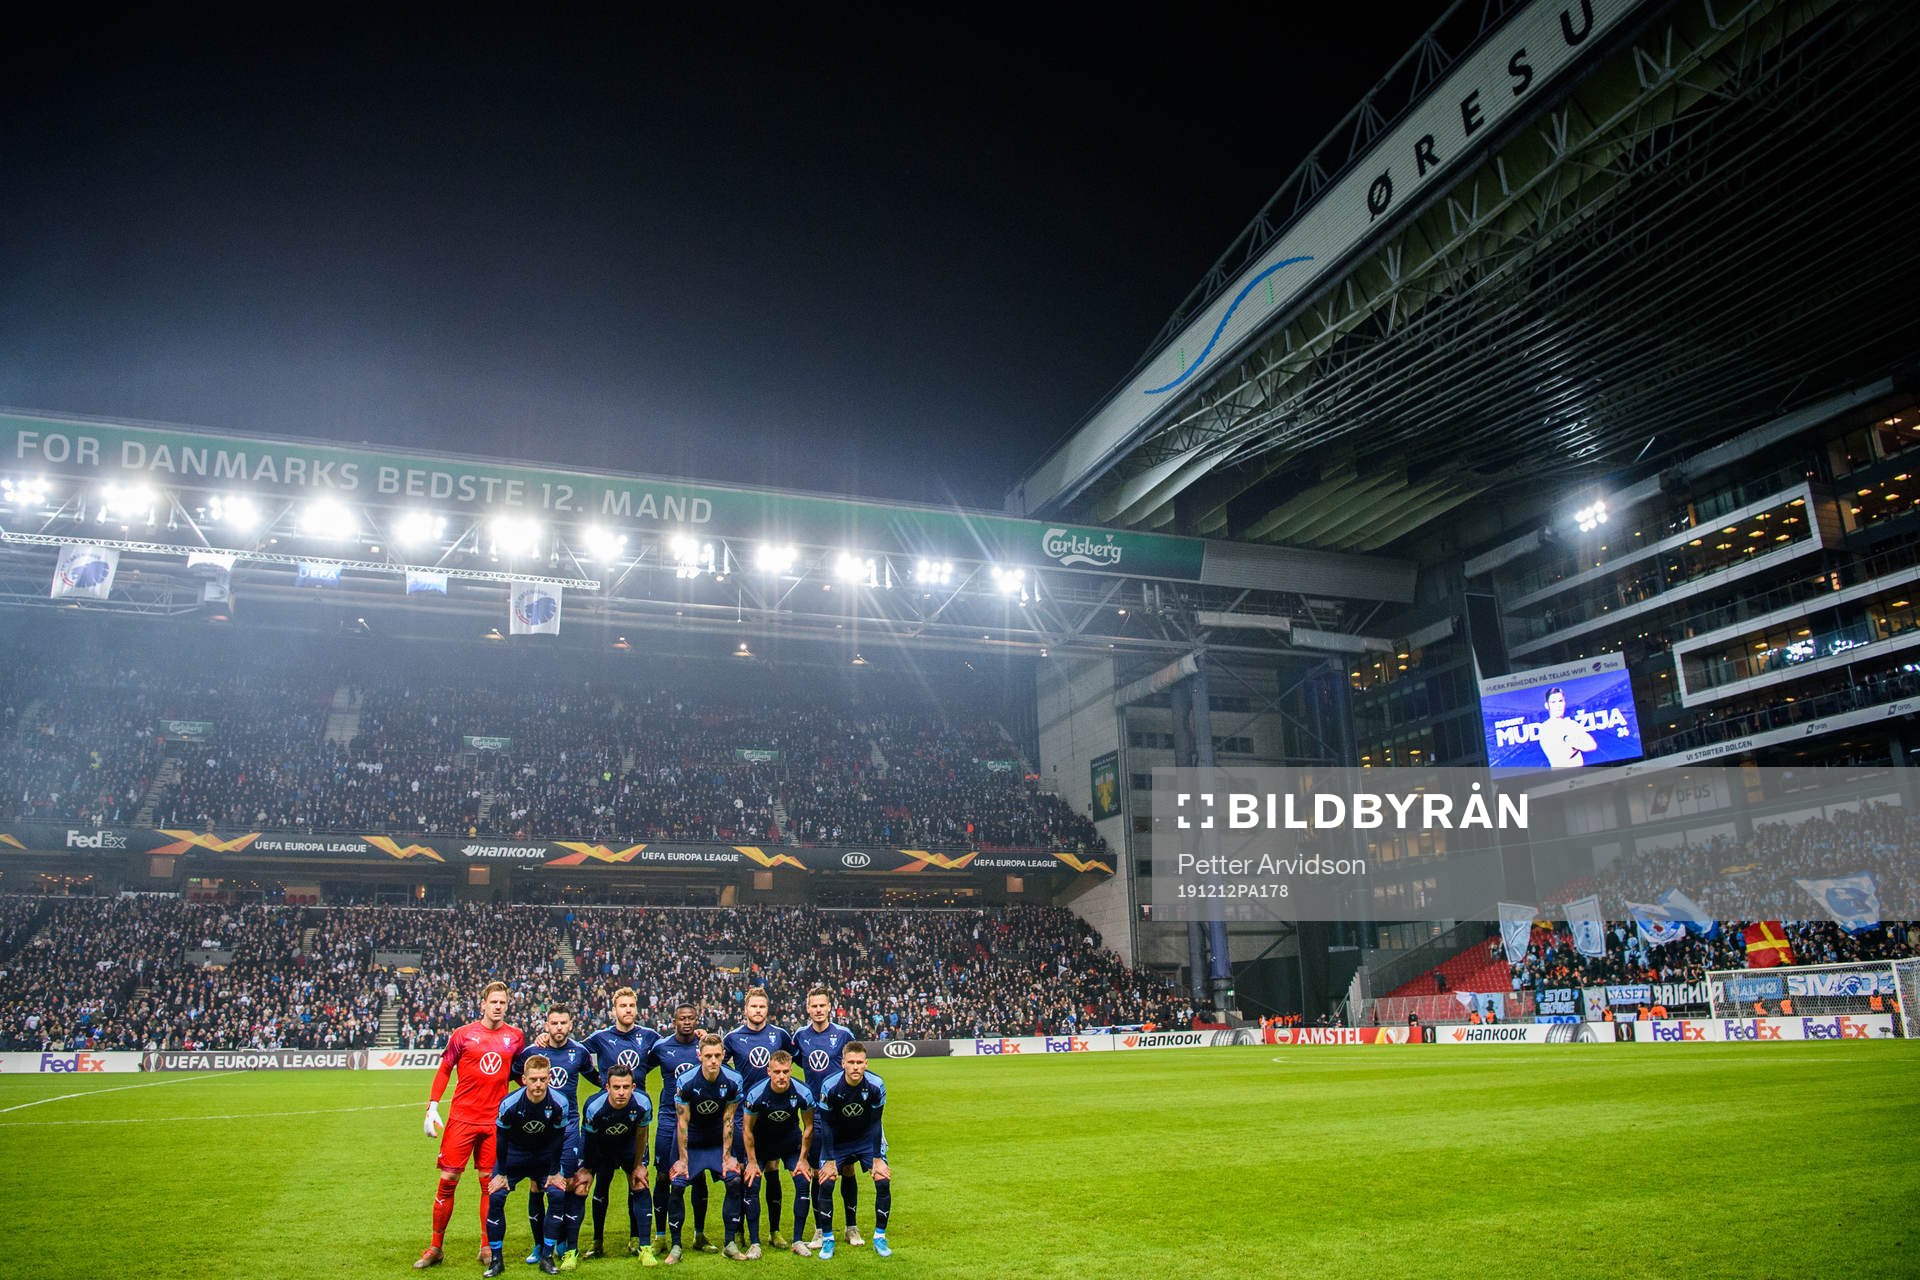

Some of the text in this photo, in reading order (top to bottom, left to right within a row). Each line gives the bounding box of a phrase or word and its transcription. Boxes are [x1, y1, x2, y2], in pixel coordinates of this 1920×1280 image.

[17, 431, 712, 524] FOR DANMARKS BEDSTE 12. MAND
[1042, 528, 1122, 565] Carlsberg
[1603, 661, 1618, 670] Telia
[1695, 747, 1724, 760] STARTER
[1676, 784, 1711, 803] DFDS
[66, 830, 127, 849] FedEx
[255, 841, 367, 853] UEFA EUROPA LEAGUE
[641, 852, 739, 862] UEFA EUROPA LEAGUE
[845, 854, 868, 867] KIA
[974, 858, 1057, 868] UEFA EUROPA LEAGUE
[1652, 1020, 1706, 1041] FedEx
[1724, 1018, 1782, 1040] FedEx
[1802, 1016, 1869, 1039] FedEx
[1045, 1036, 1089, 1052] FedEx
[1297, 1028, 1364, 1045] AMSTEL
[887, 1043, 913, 1056] KIA
[975, 1039, 1021, 1055] FedEx
[40, 1053, 105, 1072] FedEx
[165, 1054, 347, 1069] UEFA EUROPA LEAGUE
